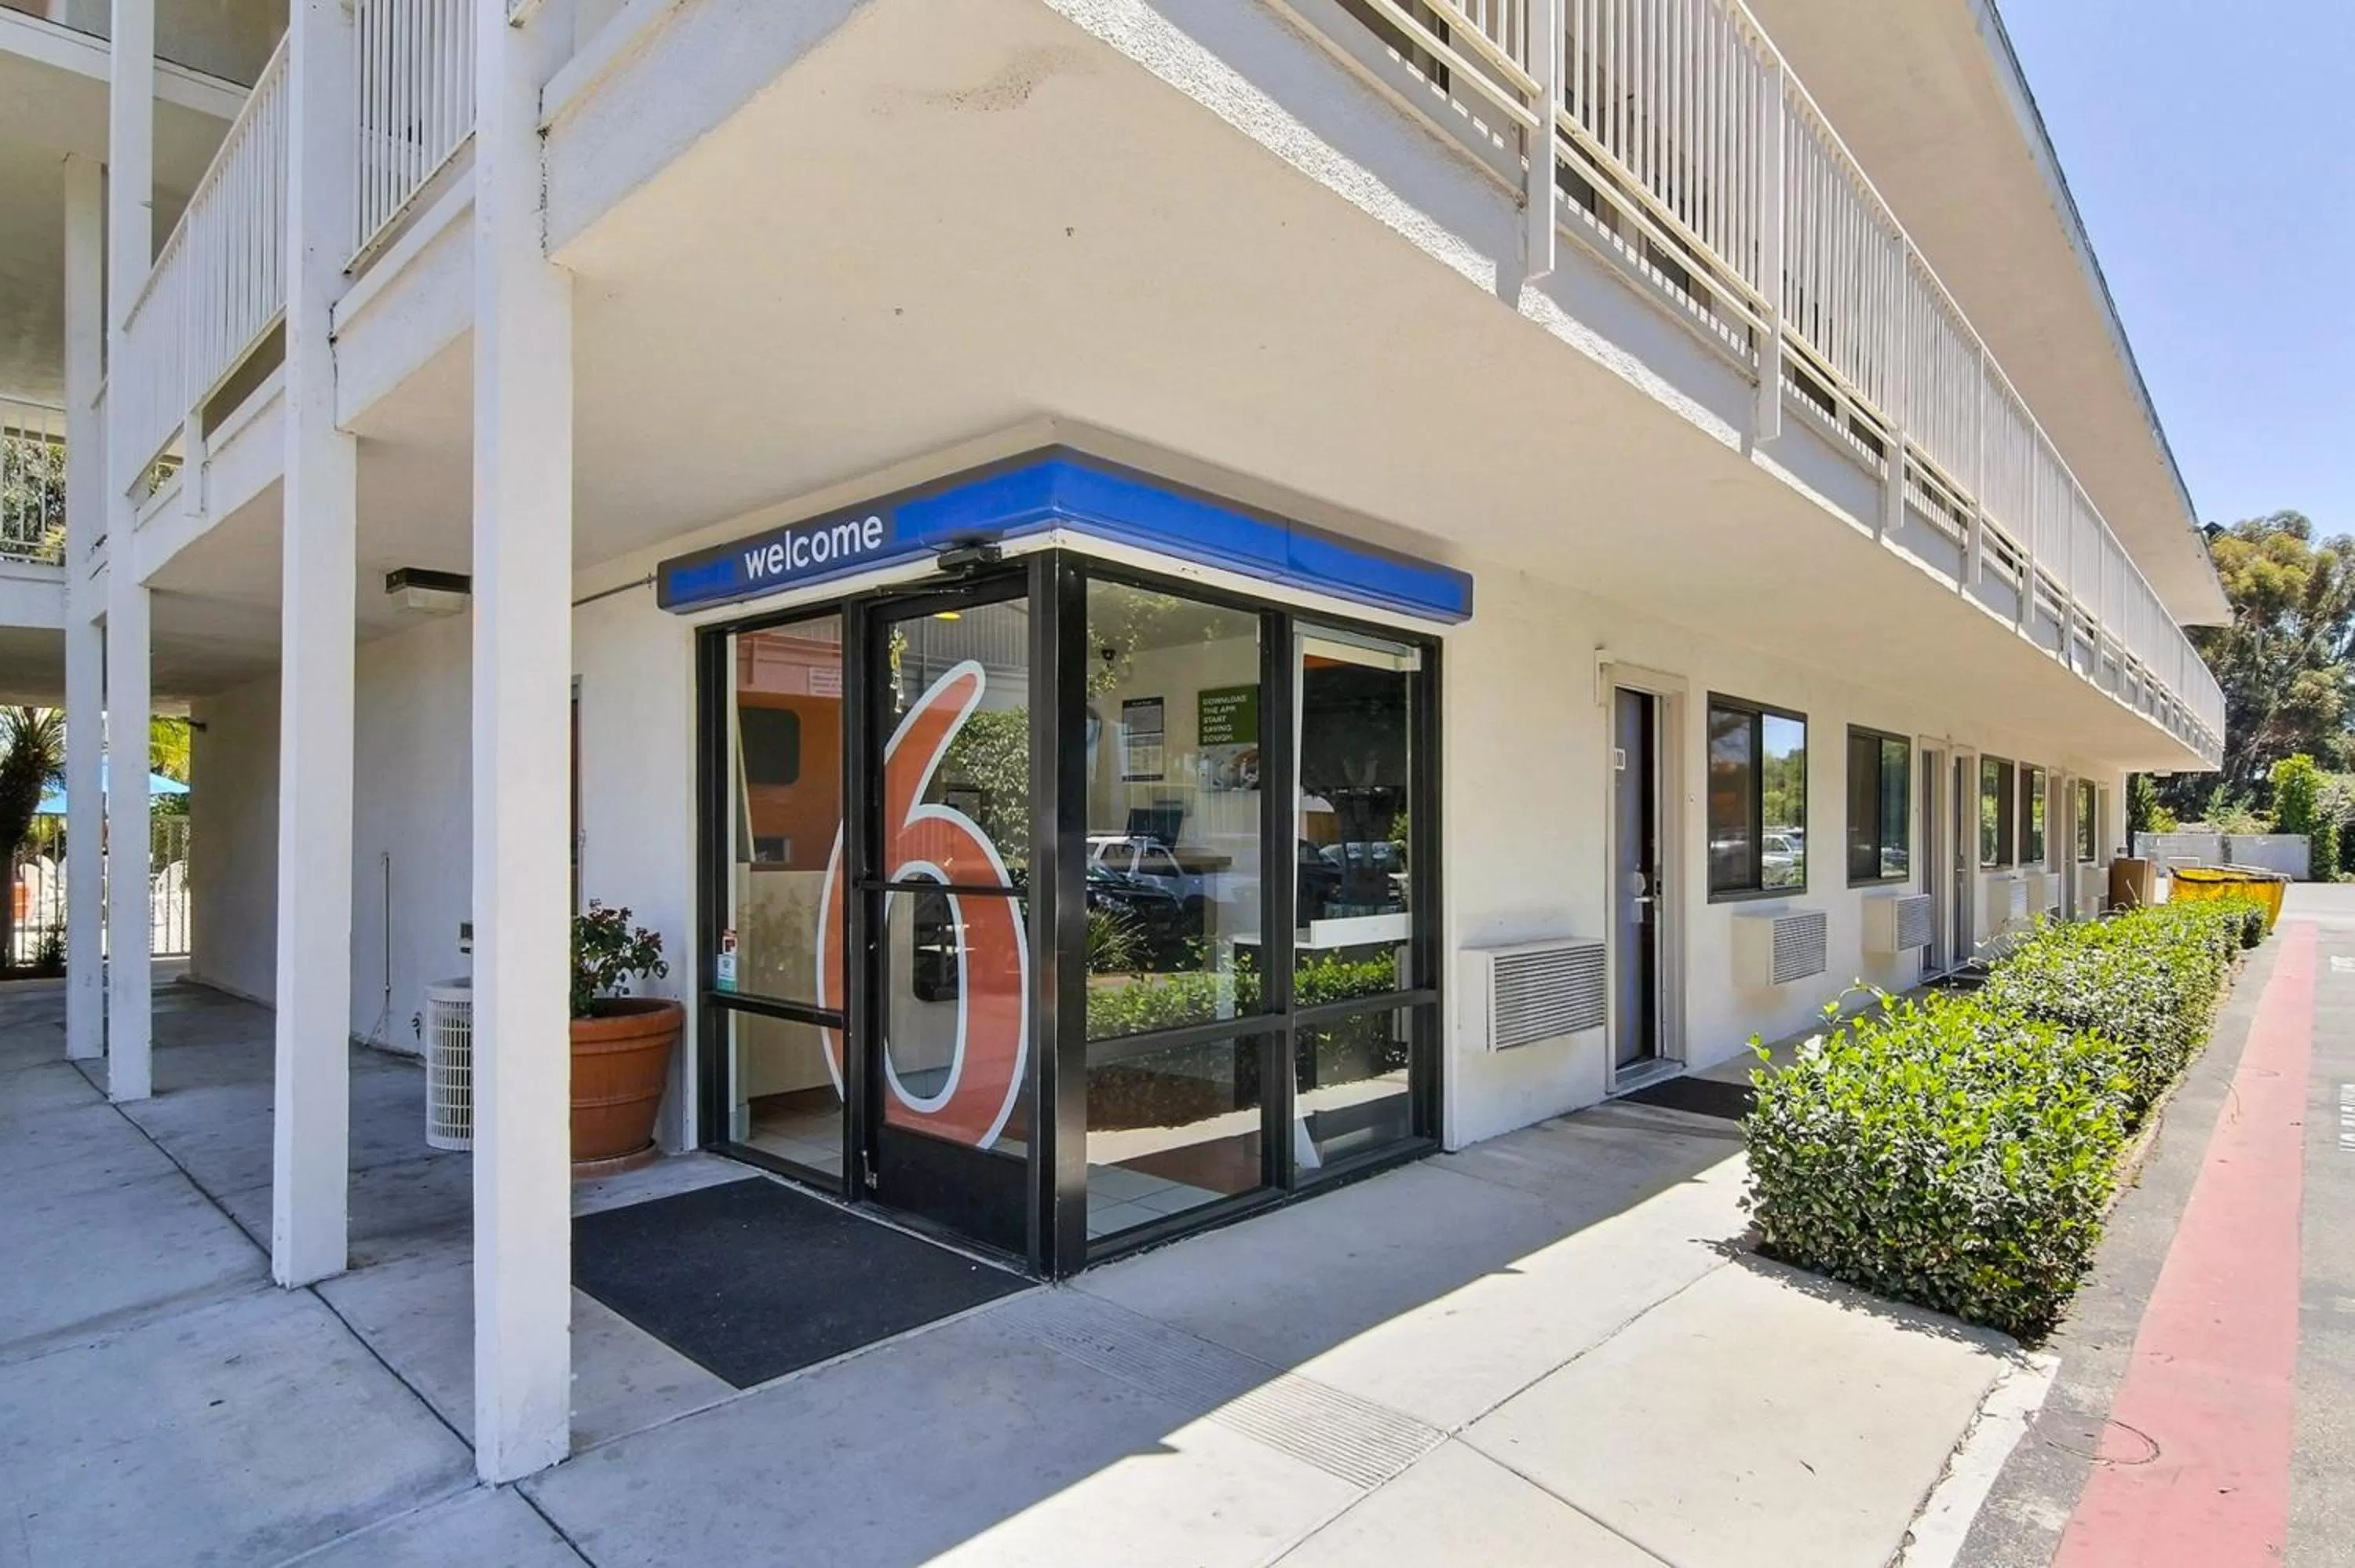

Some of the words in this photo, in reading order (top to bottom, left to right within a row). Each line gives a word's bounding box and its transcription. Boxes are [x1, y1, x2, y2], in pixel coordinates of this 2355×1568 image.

[744, 516, 883, 581] welcome
[1203, 715, 1226, 724] START
[816, 659, 1028, 1149] 6
